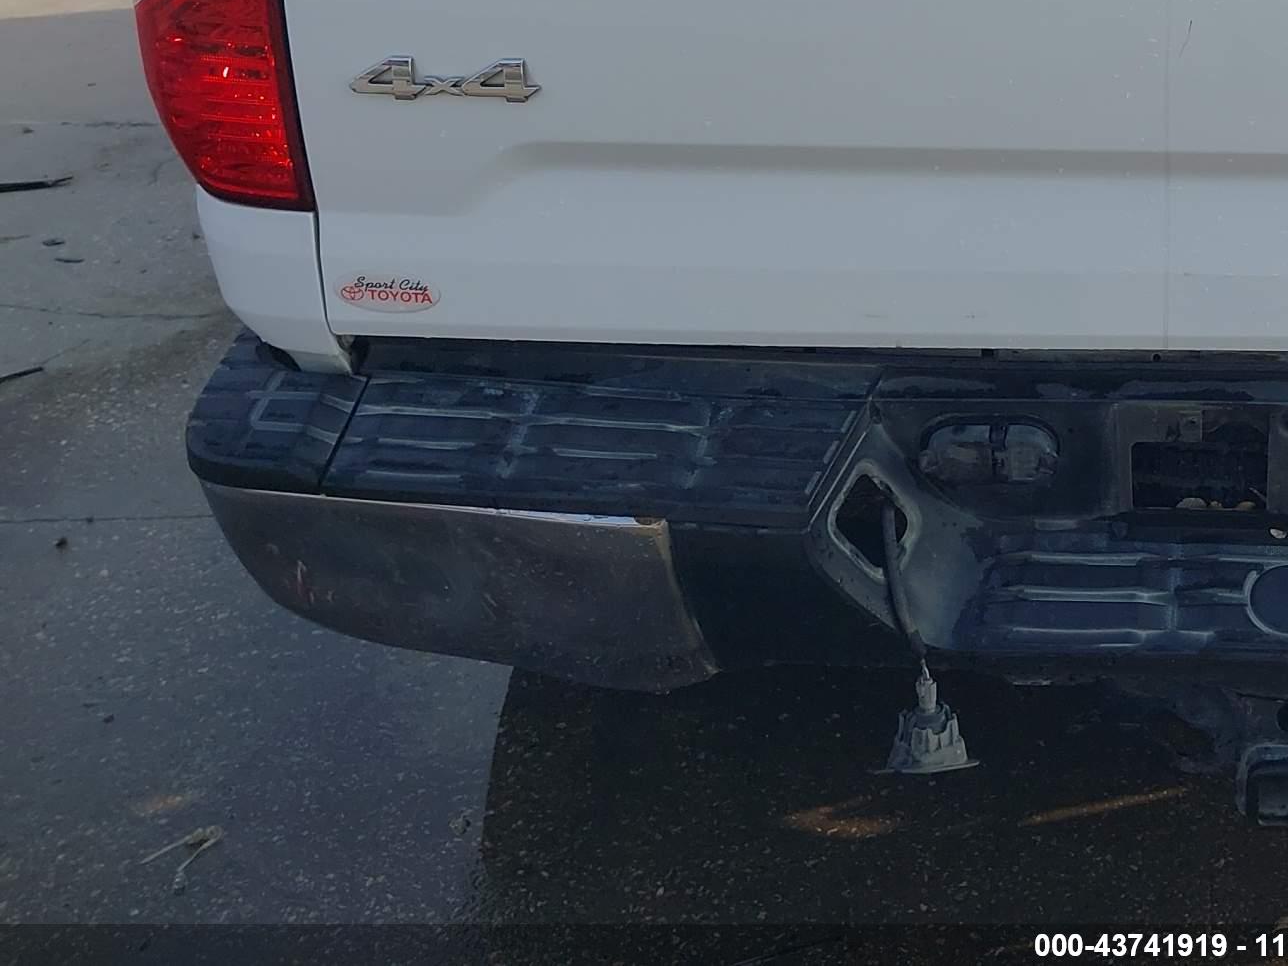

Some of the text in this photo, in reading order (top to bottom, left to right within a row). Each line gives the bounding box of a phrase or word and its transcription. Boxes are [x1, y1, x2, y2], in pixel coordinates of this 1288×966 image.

[354, 276, 429, 295] Sport City
[368, 288, 433, 304] TOYOTA
